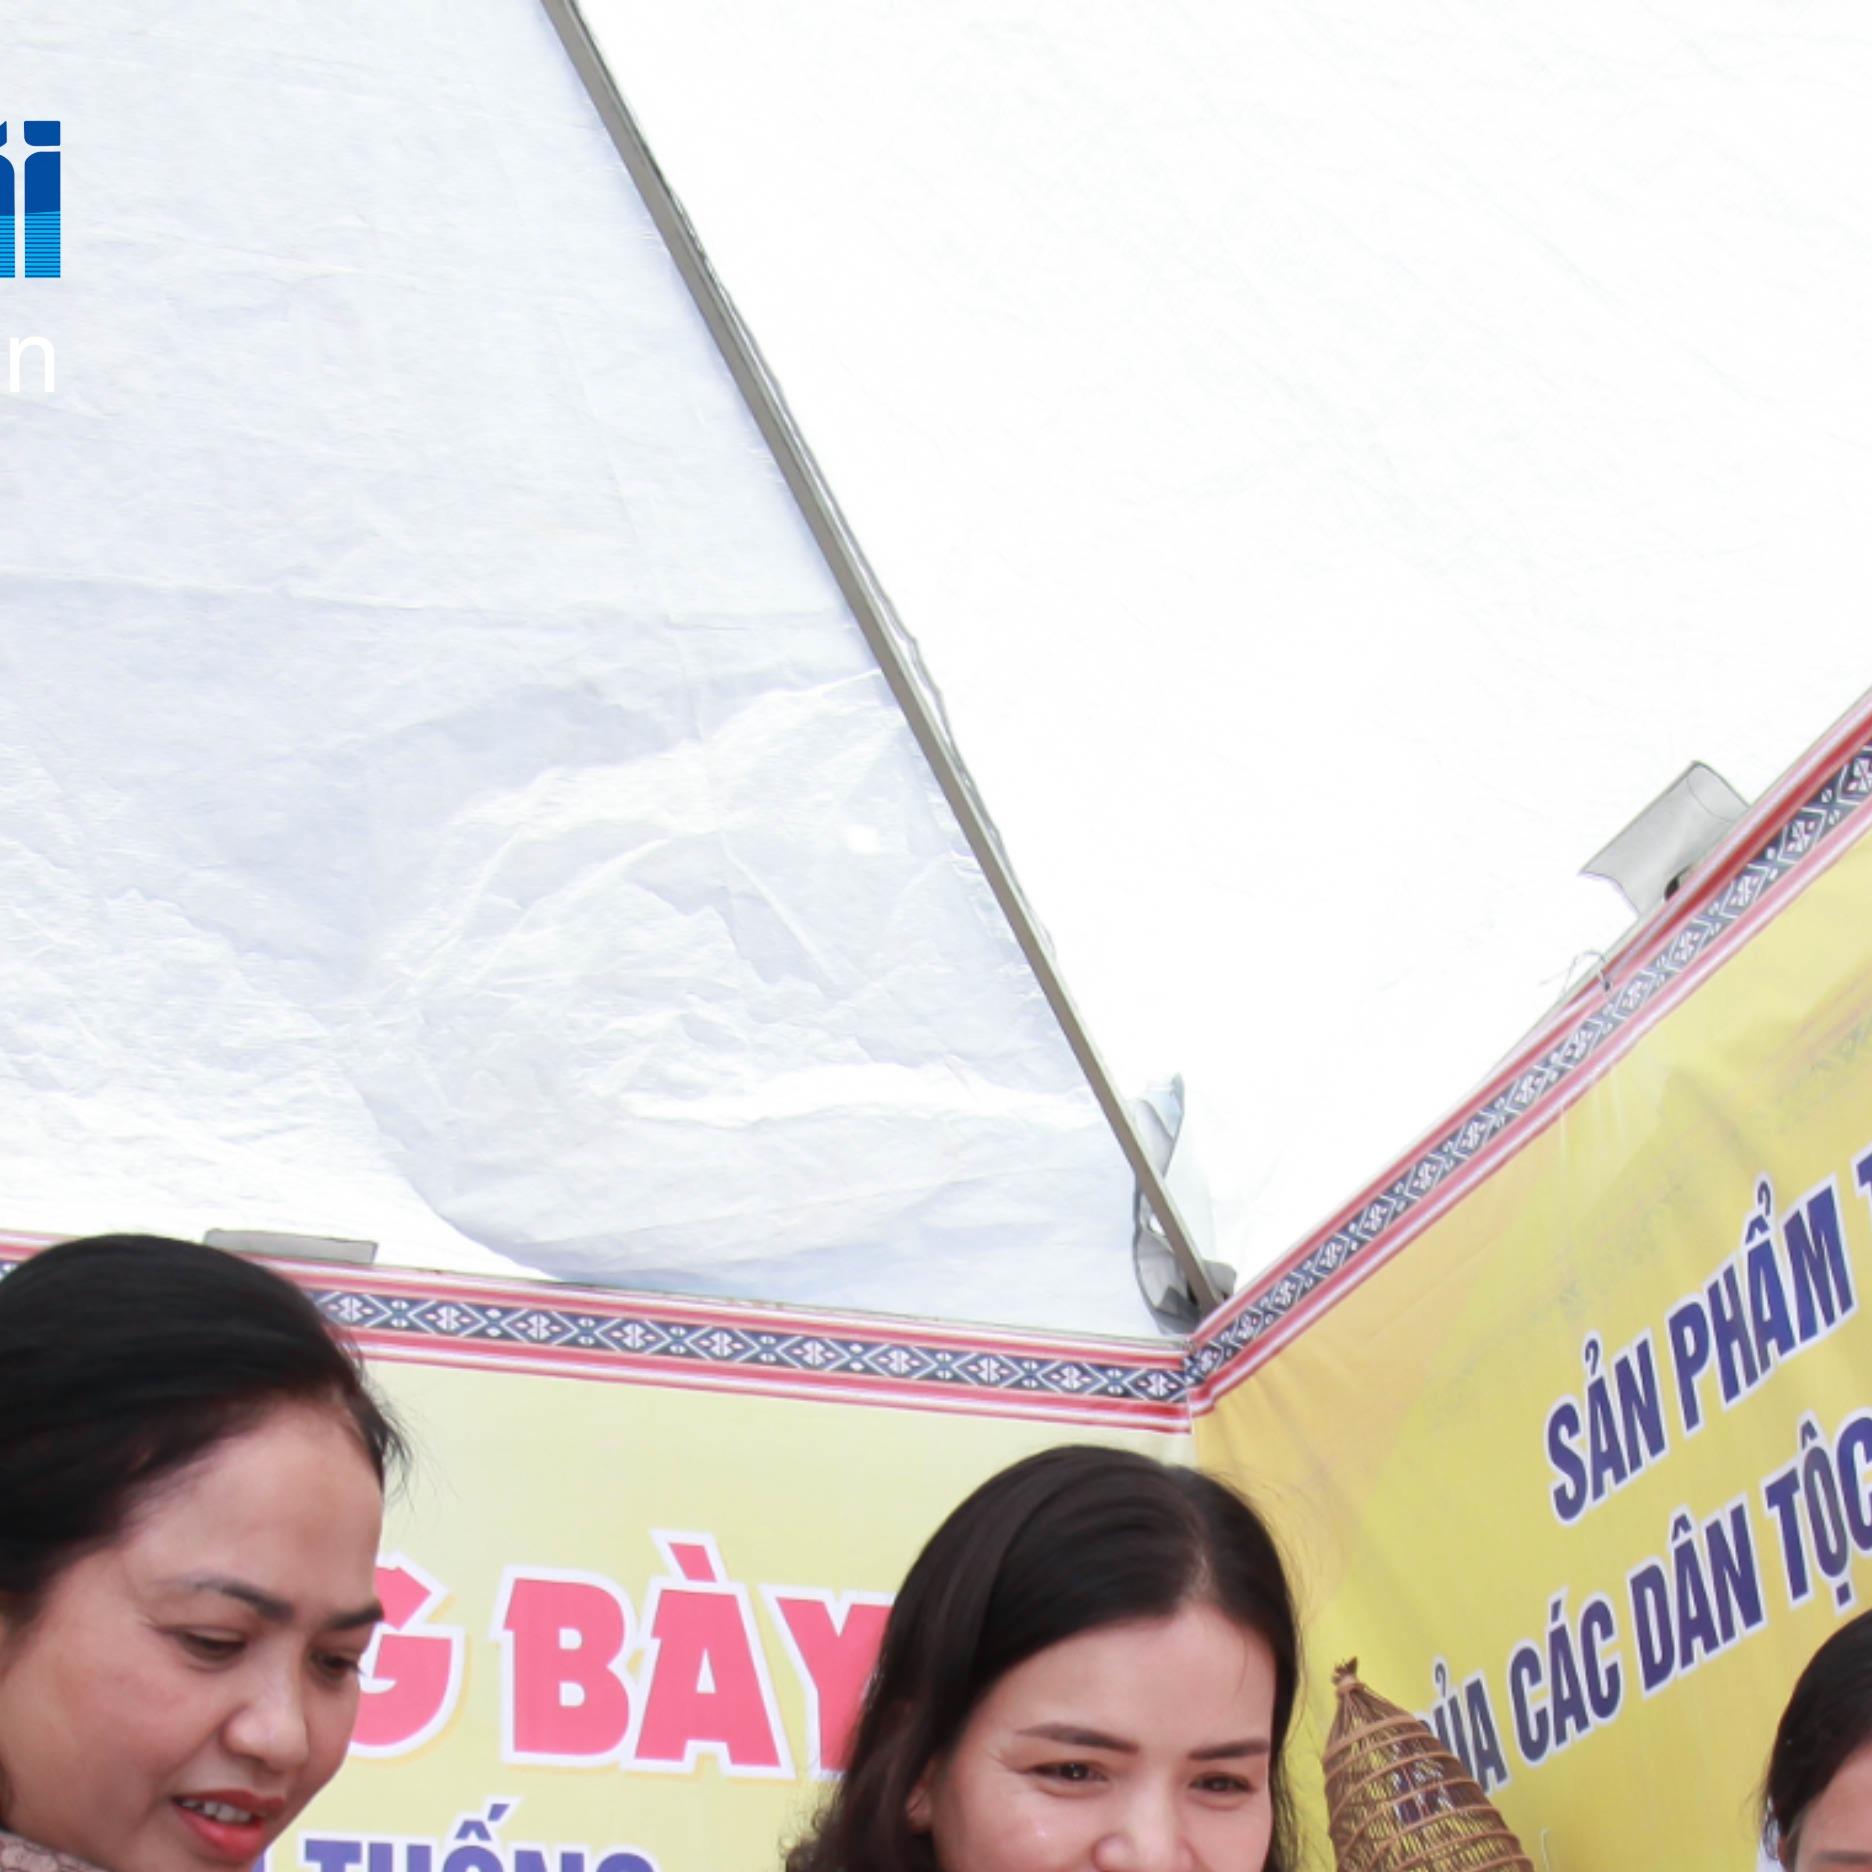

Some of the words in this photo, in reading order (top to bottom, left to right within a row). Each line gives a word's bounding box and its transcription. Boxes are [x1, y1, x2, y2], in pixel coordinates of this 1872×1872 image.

[1547, 1338, 1666, 1523] SẢN
[1669, 1181, 1854, 1431] PHẨM
[503, 1541, 896, 1772] BÀY
[1510, 1596, 1621, 1762] CÁC
[1629, 1512, 1763, 1690] DÂN
